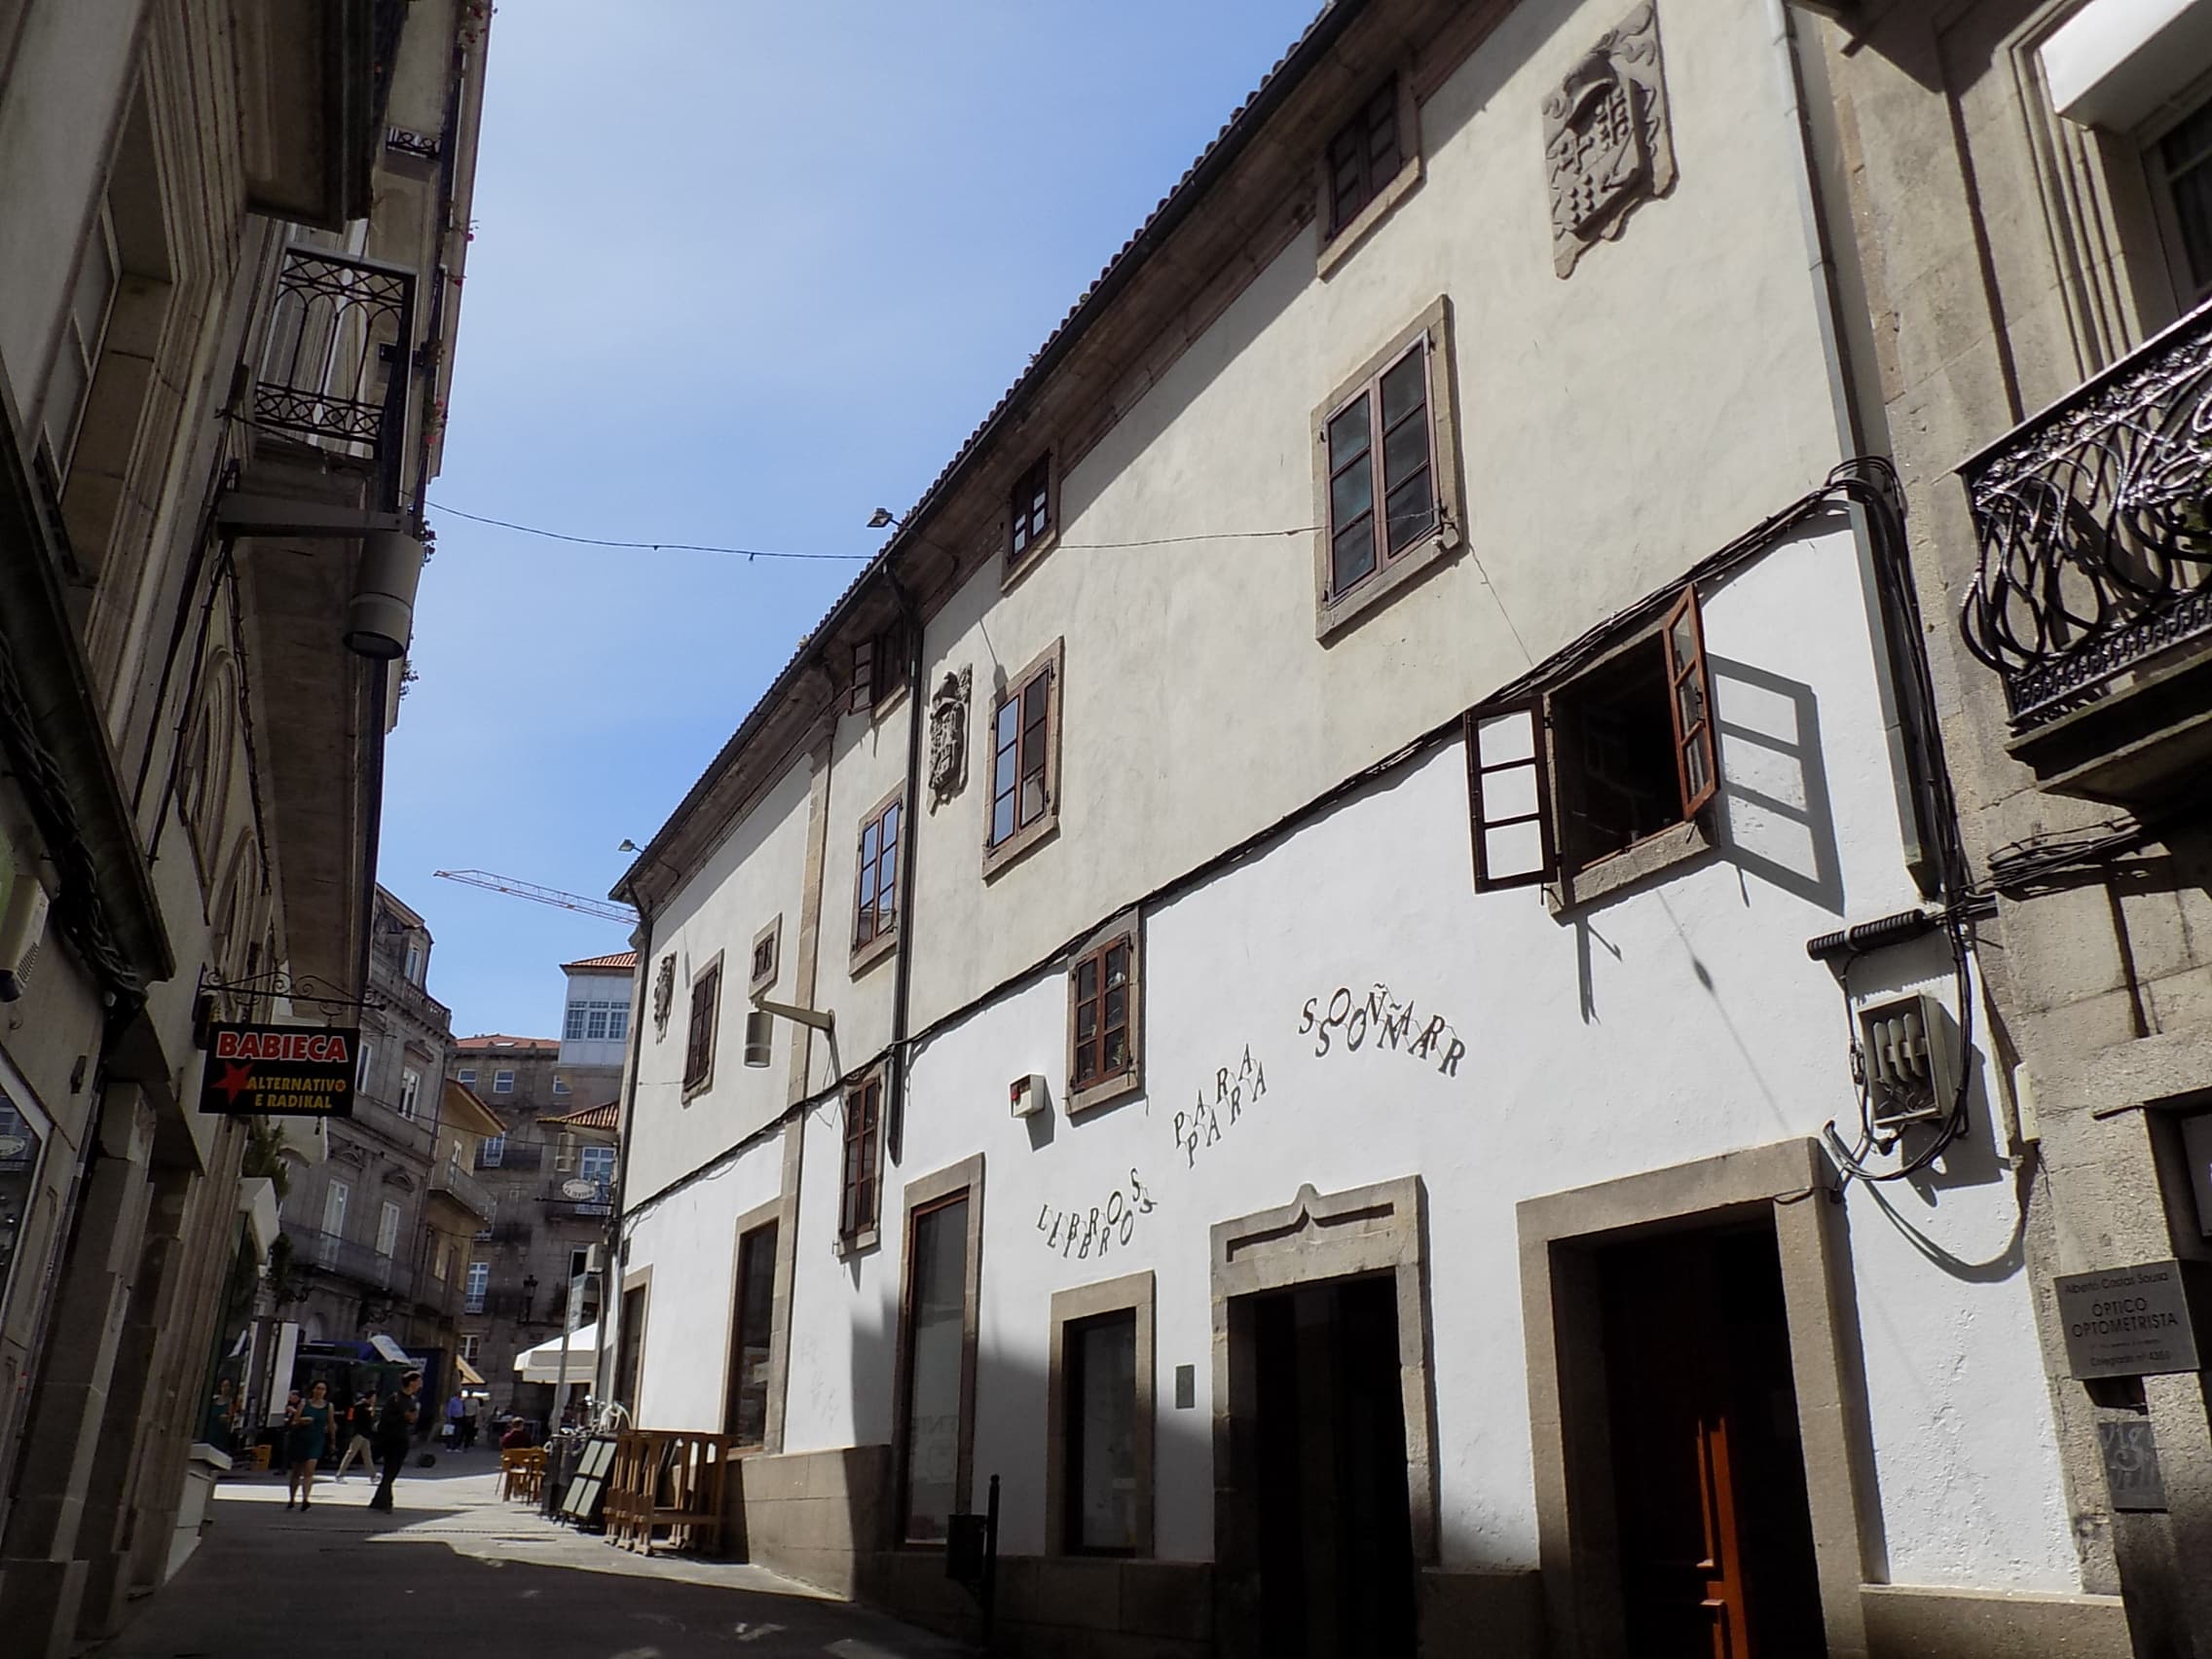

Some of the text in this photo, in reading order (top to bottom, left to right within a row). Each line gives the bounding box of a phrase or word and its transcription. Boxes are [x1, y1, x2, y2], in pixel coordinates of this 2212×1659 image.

[216, 1031, 349, 1062] BABIECA
[245, 1076, 347, 1092] ALTERNATIVO
[254, 1093, 264, 1107] E
[1037, 982, 1448, 1241] LIBROS PARA SOÑAR
[2071, 1312, 2178, 1338] OPTOMETRISTA
